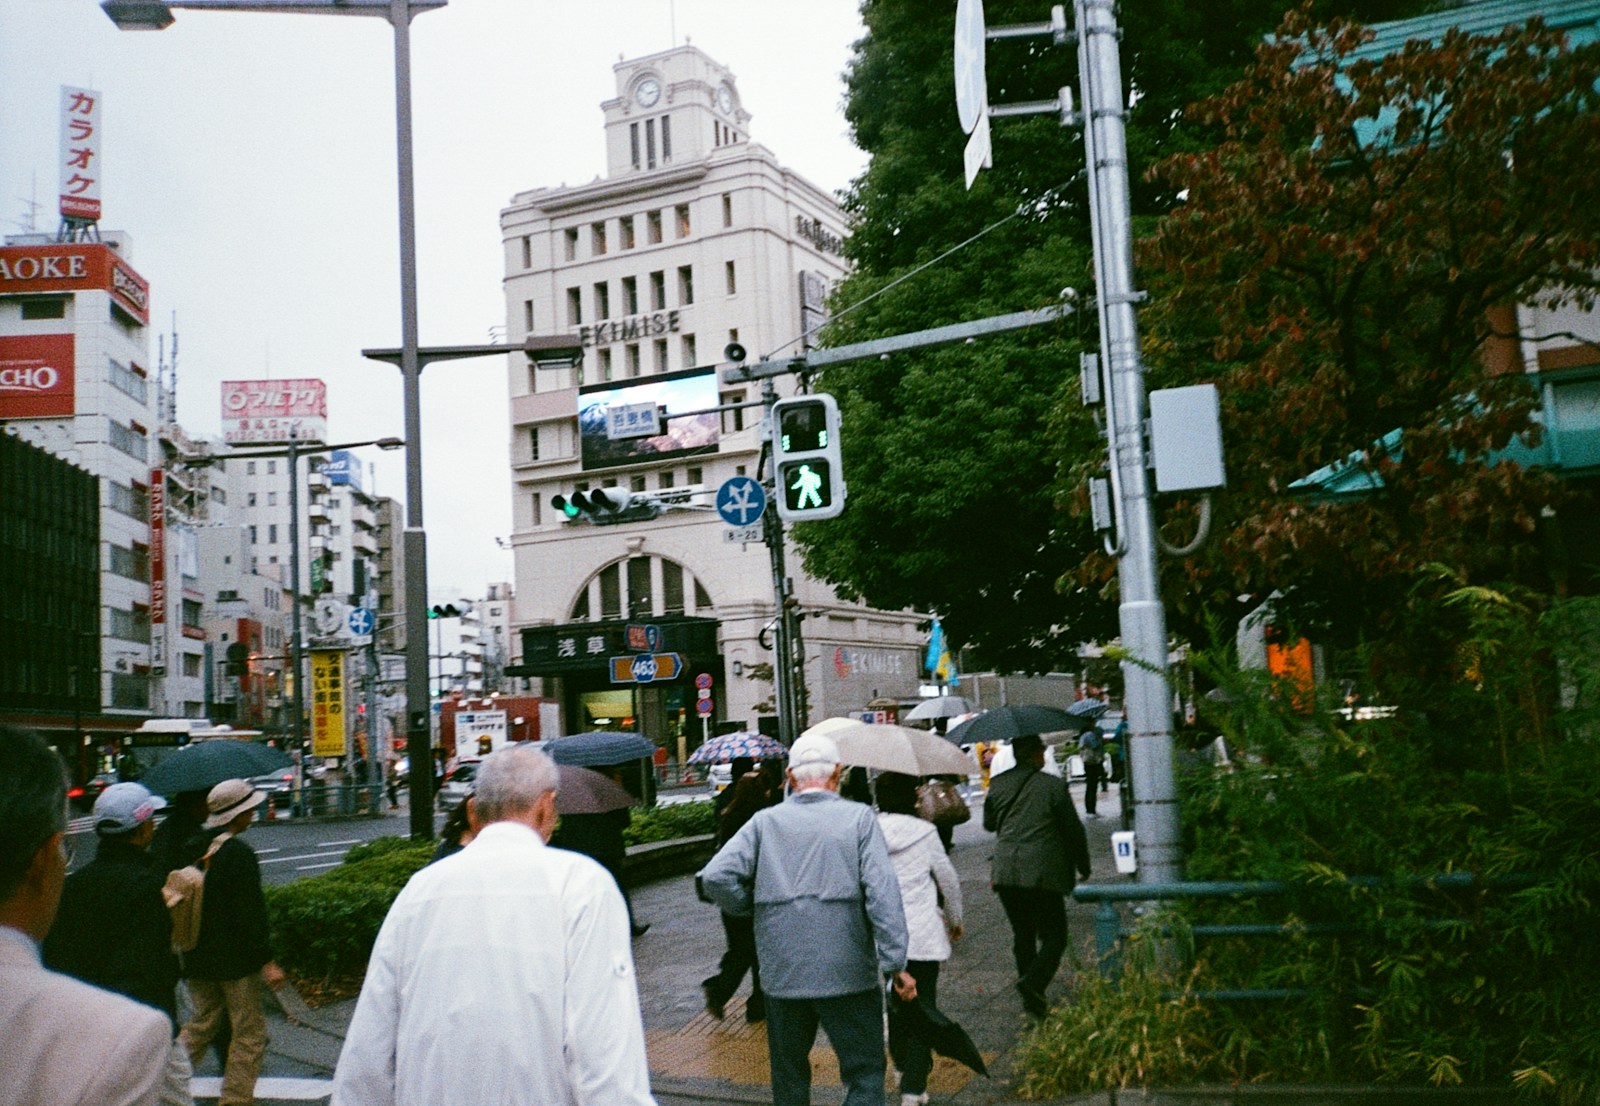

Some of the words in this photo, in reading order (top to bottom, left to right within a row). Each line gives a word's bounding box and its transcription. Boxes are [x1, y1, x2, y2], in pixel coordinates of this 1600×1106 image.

[66, 91, 95, 195] カラオケ
[580, 309, 680, 348] EKIMISE
[557, 636, 605, 658] 浅草
[633, 660, 655, 676] 463
